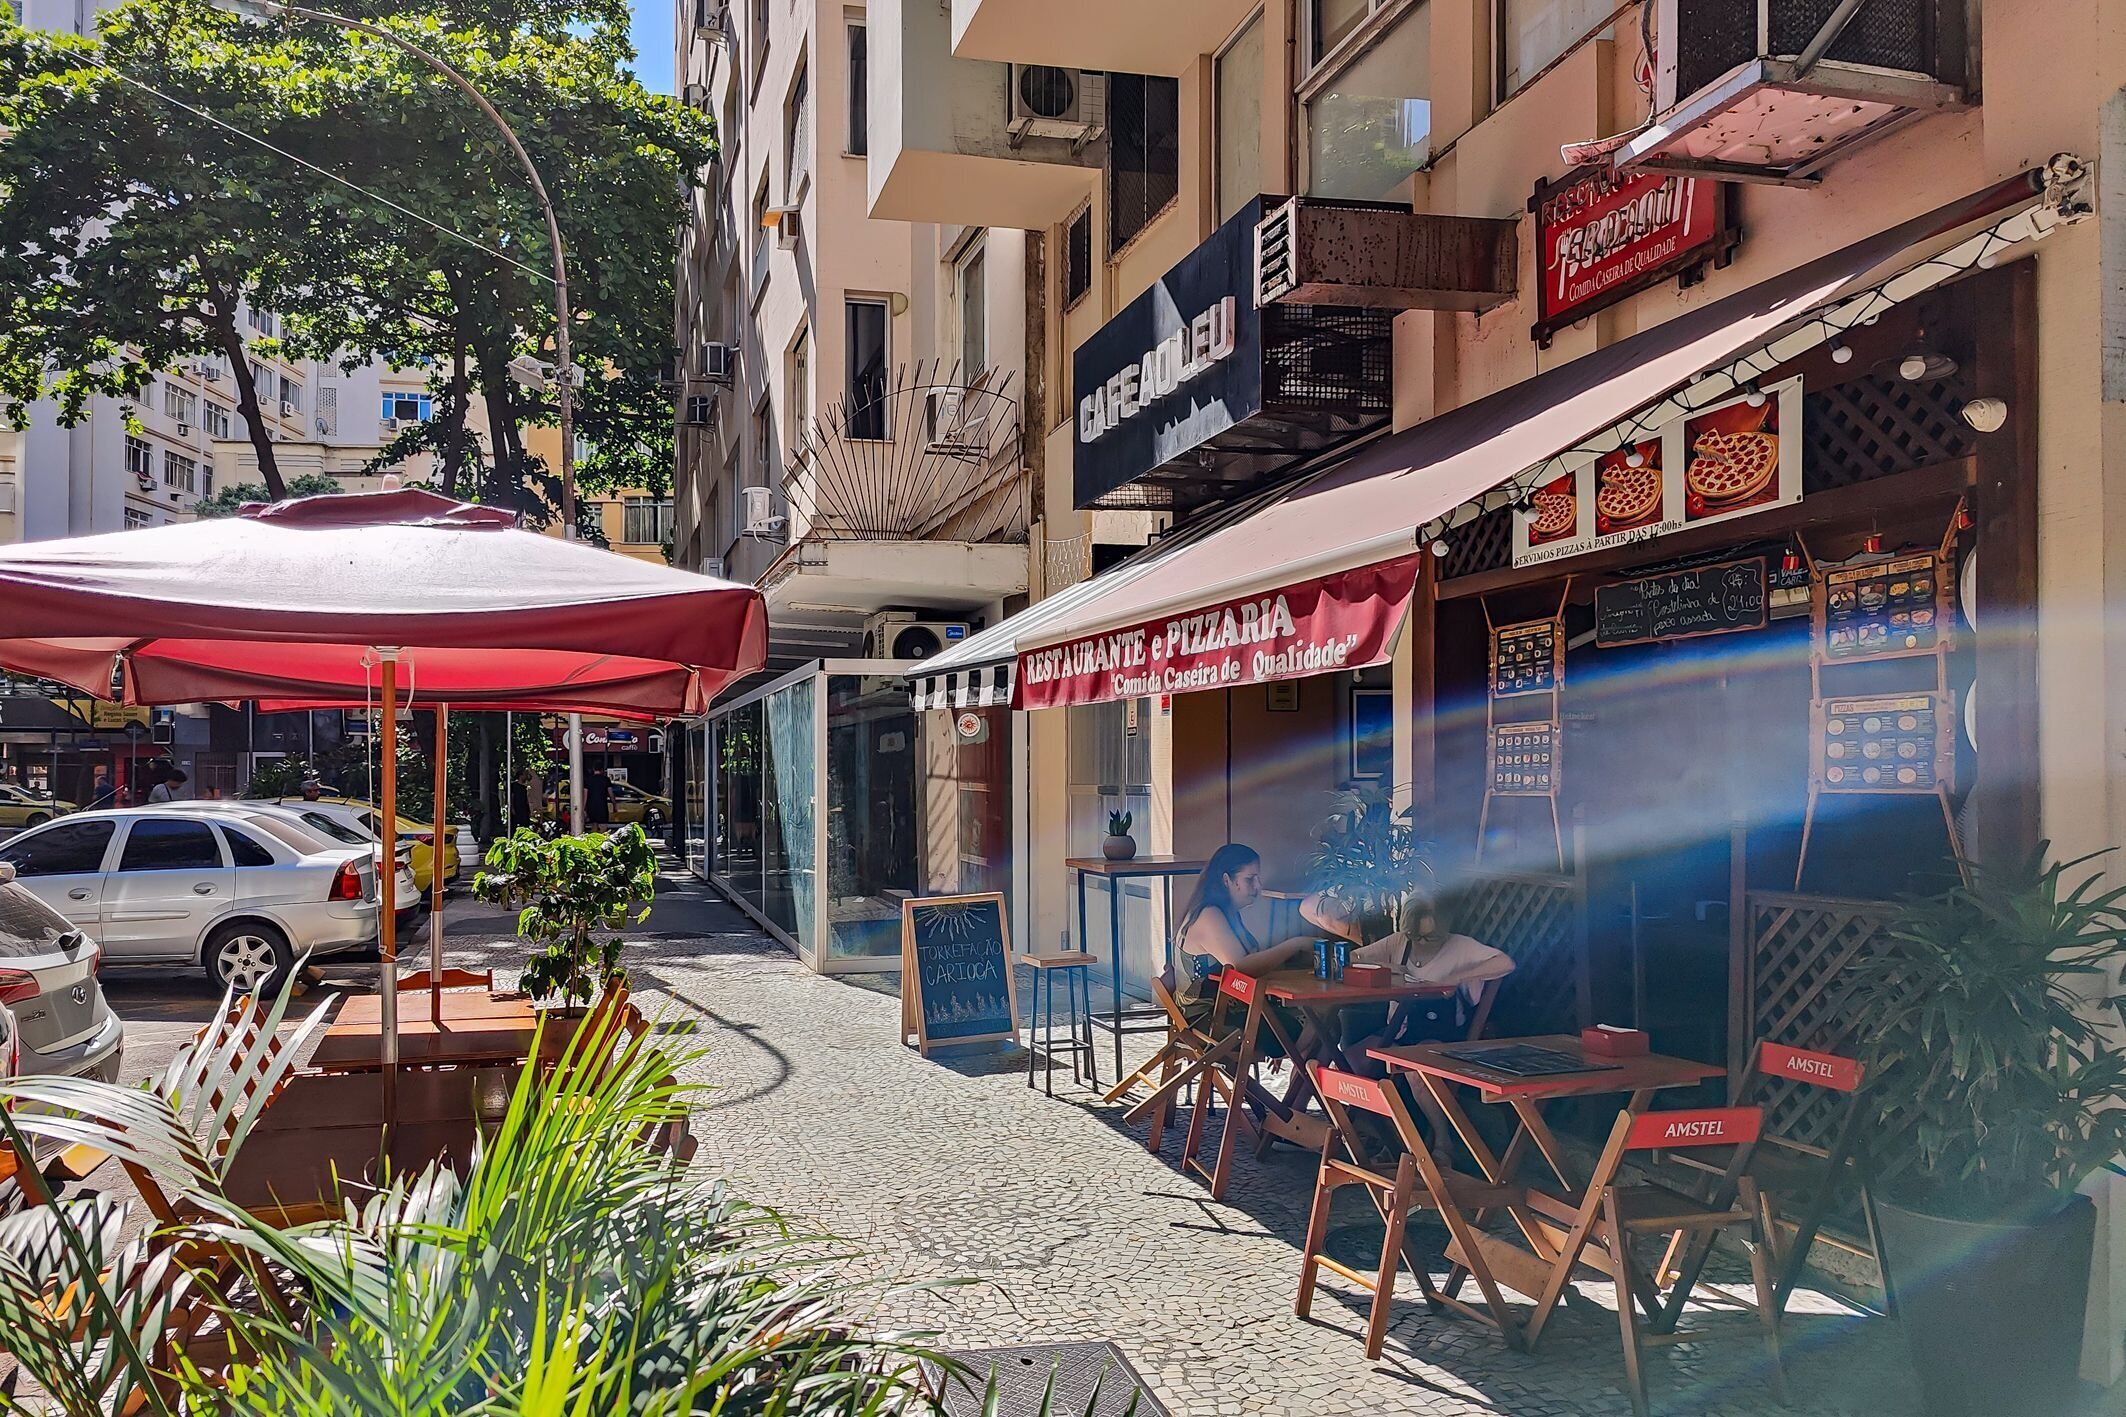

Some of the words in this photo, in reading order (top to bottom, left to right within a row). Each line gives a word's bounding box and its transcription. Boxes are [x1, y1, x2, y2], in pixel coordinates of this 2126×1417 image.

[1569, 277, 1596, 302] COMIDA
[1595, 263, 1624, 290] CASEIRA
[1624, 258, 1634, 276] DE
[1634, 235, 1677, 271] QUALIDADE
[1514, 550, 1555, 567] SERVIMOS
[1556, 542, 1585, 559] PIZZAS
[1586, 537, 1593, 550] À
[1594, 534, 1627, 549] PARTIR
[1627, 526, 1647, 543] DAS
[1650, 519, 1683, 537] 17:00hs
[1026, 628, 1147, 685] RESTAURANTE
[1151, 634, 1162, 661] e
[1165, 594, 1297, 659] PIZZARIA
[1164, 662, 1219, 690] Caseira
[1220, 655, 1241, 682] de
[925, 959, 998, 987] CARIOCA
[1786, 1055, 1834, 1079] AMSTEL
[1338, 1080, 1371, 1102] AMSTEL
[1664, 1120, 1724, 1138] AMSTEL
